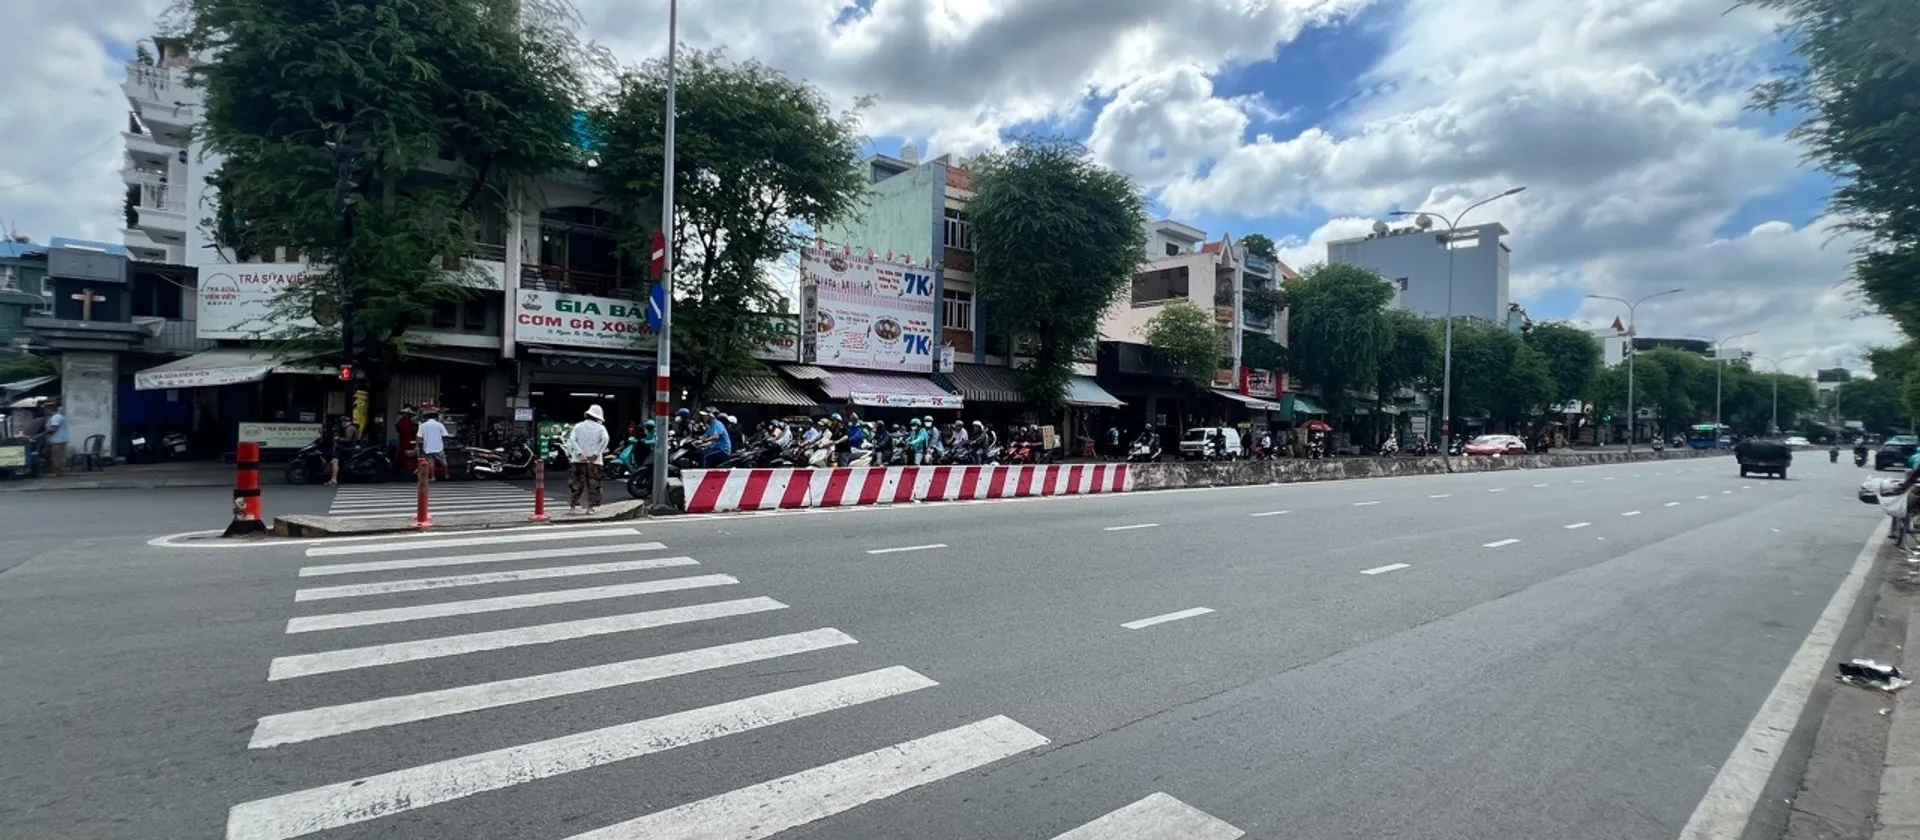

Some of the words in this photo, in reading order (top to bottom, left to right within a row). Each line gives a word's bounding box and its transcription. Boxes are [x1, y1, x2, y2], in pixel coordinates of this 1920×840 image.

[239, 272, 259, 284] TRÀ
[261, 272, 285, 284] SỮA
[904, 272, 930, 297] 7K
[555, 299, 602, 315] GIA
[517, 313, 562, 327] CƠM
[570, 316, 595, 330] GÀ
[903, 333, 930, 355] 7K
